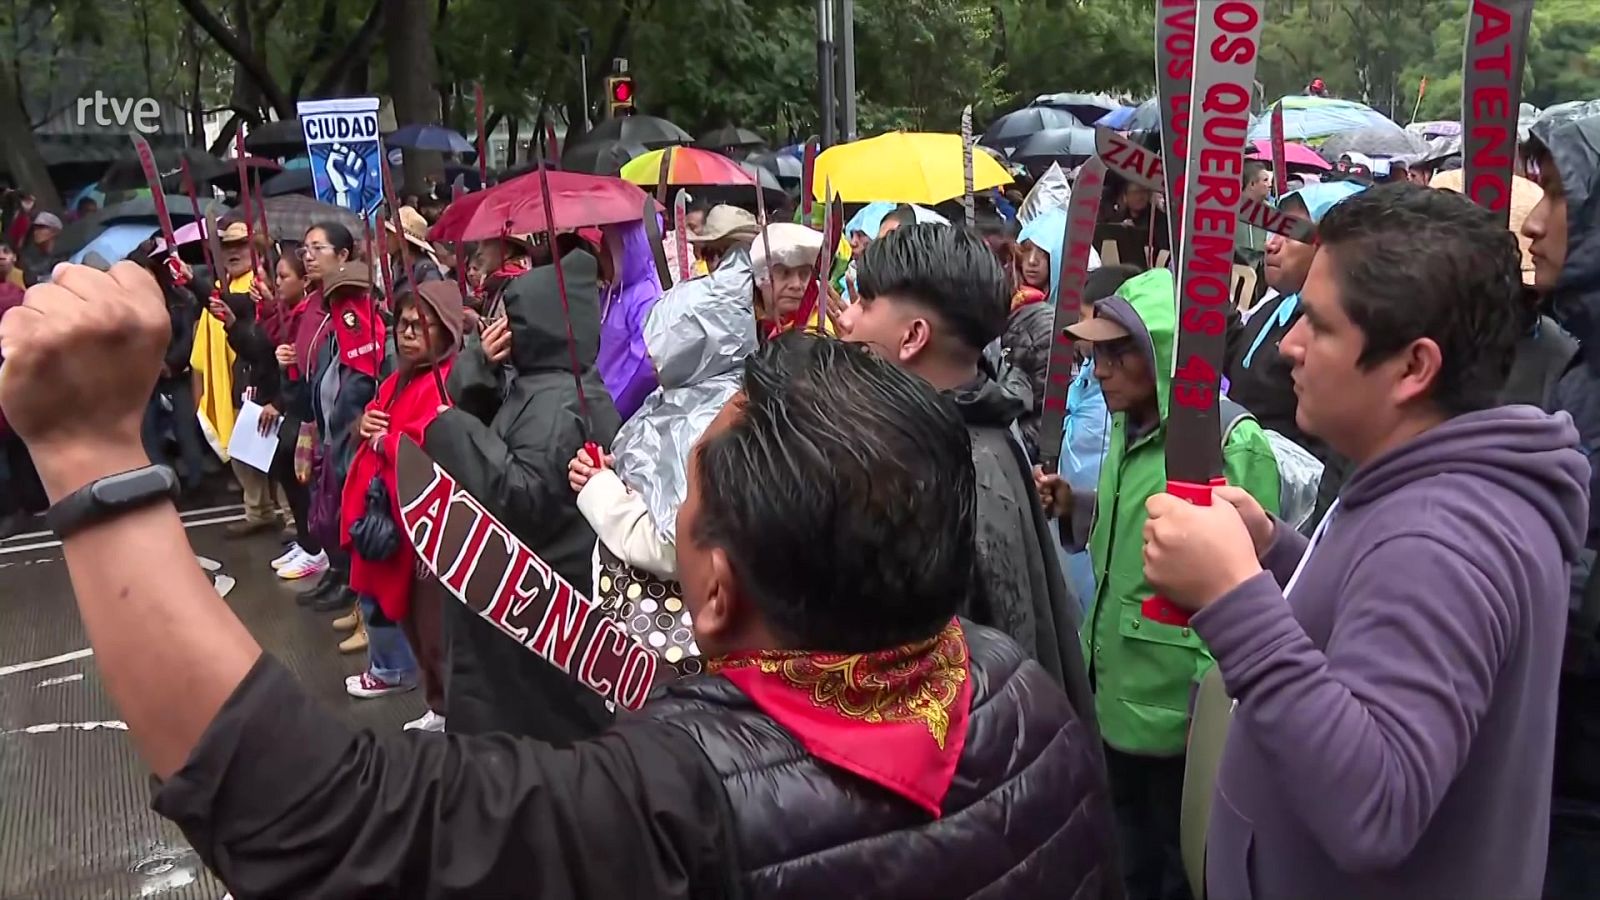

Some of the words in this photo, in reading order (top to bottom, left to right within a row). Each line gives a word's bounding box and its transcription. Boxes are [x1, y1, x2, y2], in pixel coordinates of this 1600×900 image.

[1162, 0, 1195, 79] IVOS
[1210, 2, 1258, 65] OS
[305, 116, 376, 140] CIUDAD
[1471, 0, 1513, 211] ATENC
[1182, 82, 1250, 337] QUEREMOS
[1174, 355, 1217, 411] 43
[400, 461, 659, 712] ATENCO
